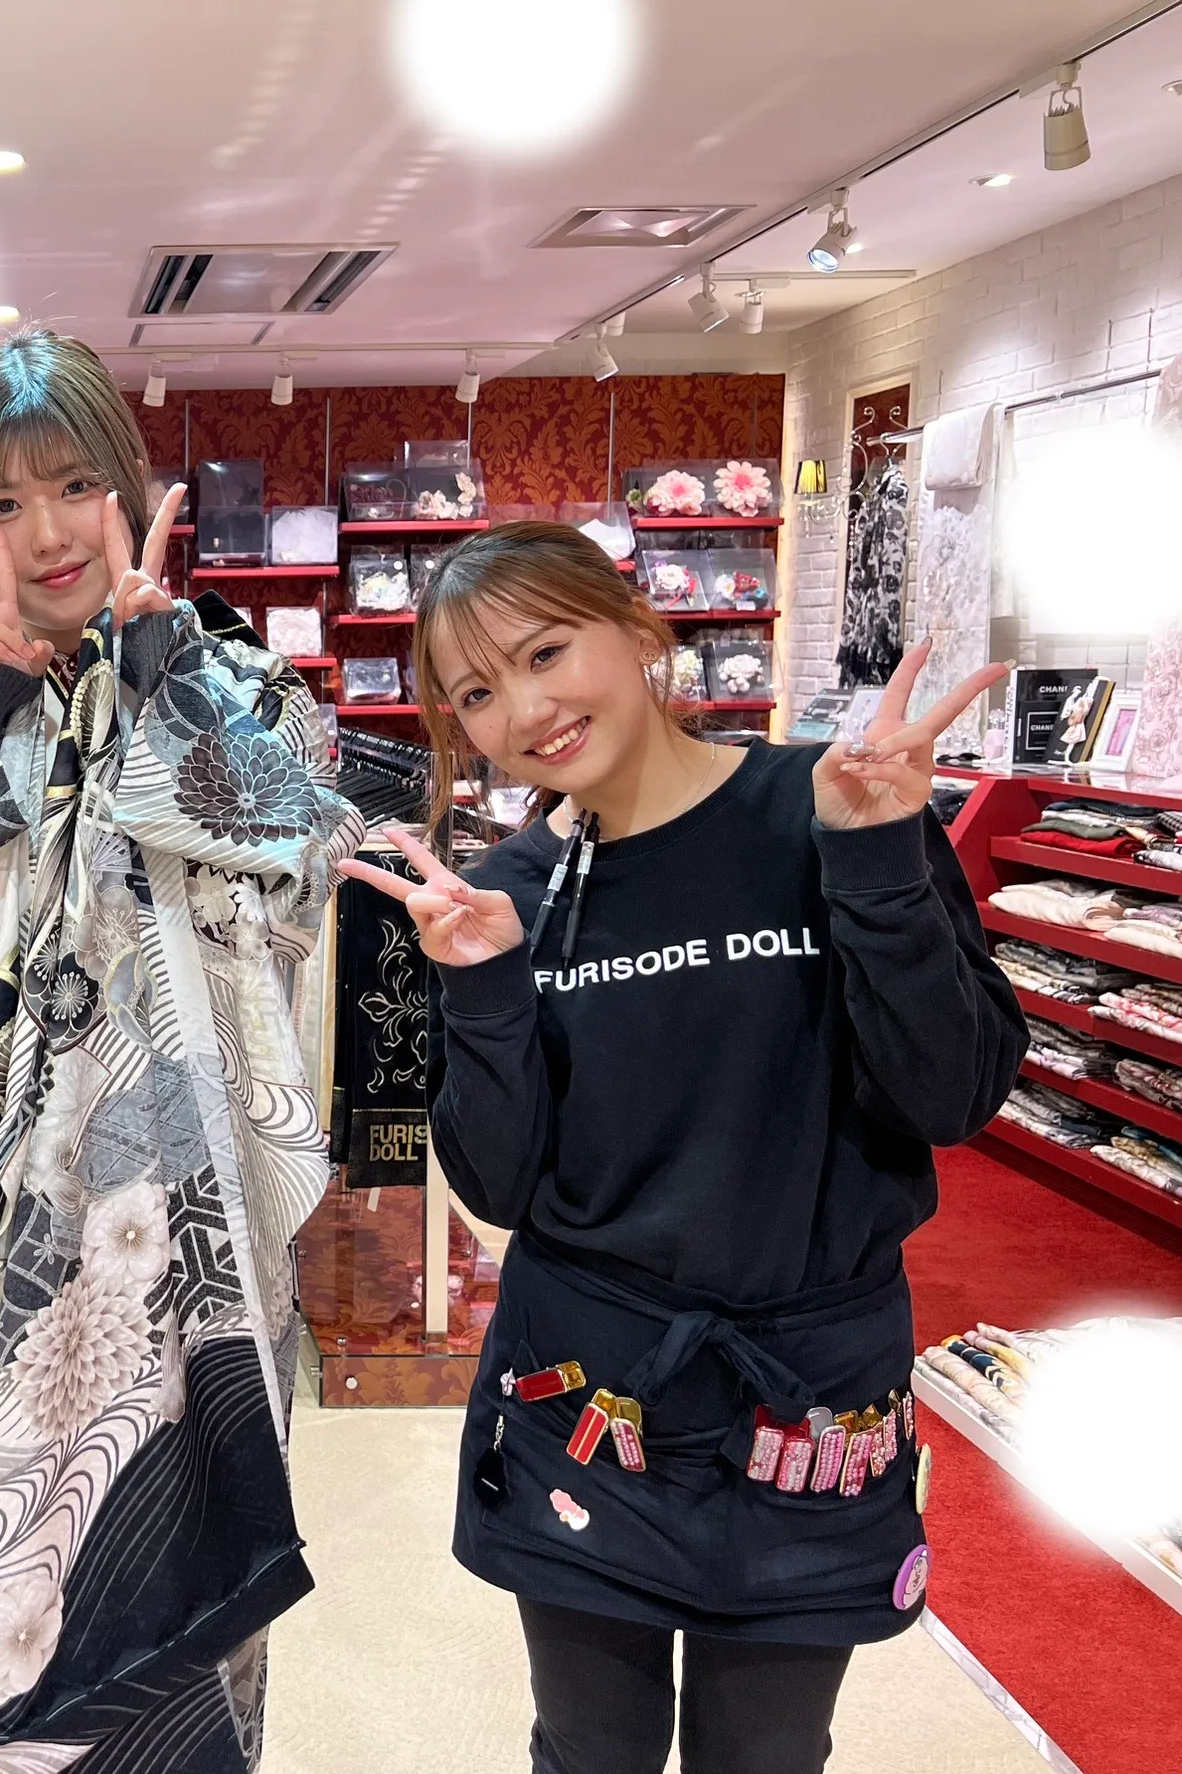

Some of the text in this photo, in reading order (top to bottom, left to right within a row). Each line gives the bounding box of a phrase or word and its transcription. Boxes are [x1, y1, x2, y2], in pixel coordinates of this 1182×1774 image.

[534, 927, 820, 994] FURISODE DOLL
[369, 1143, 419, 1161] DOLL
